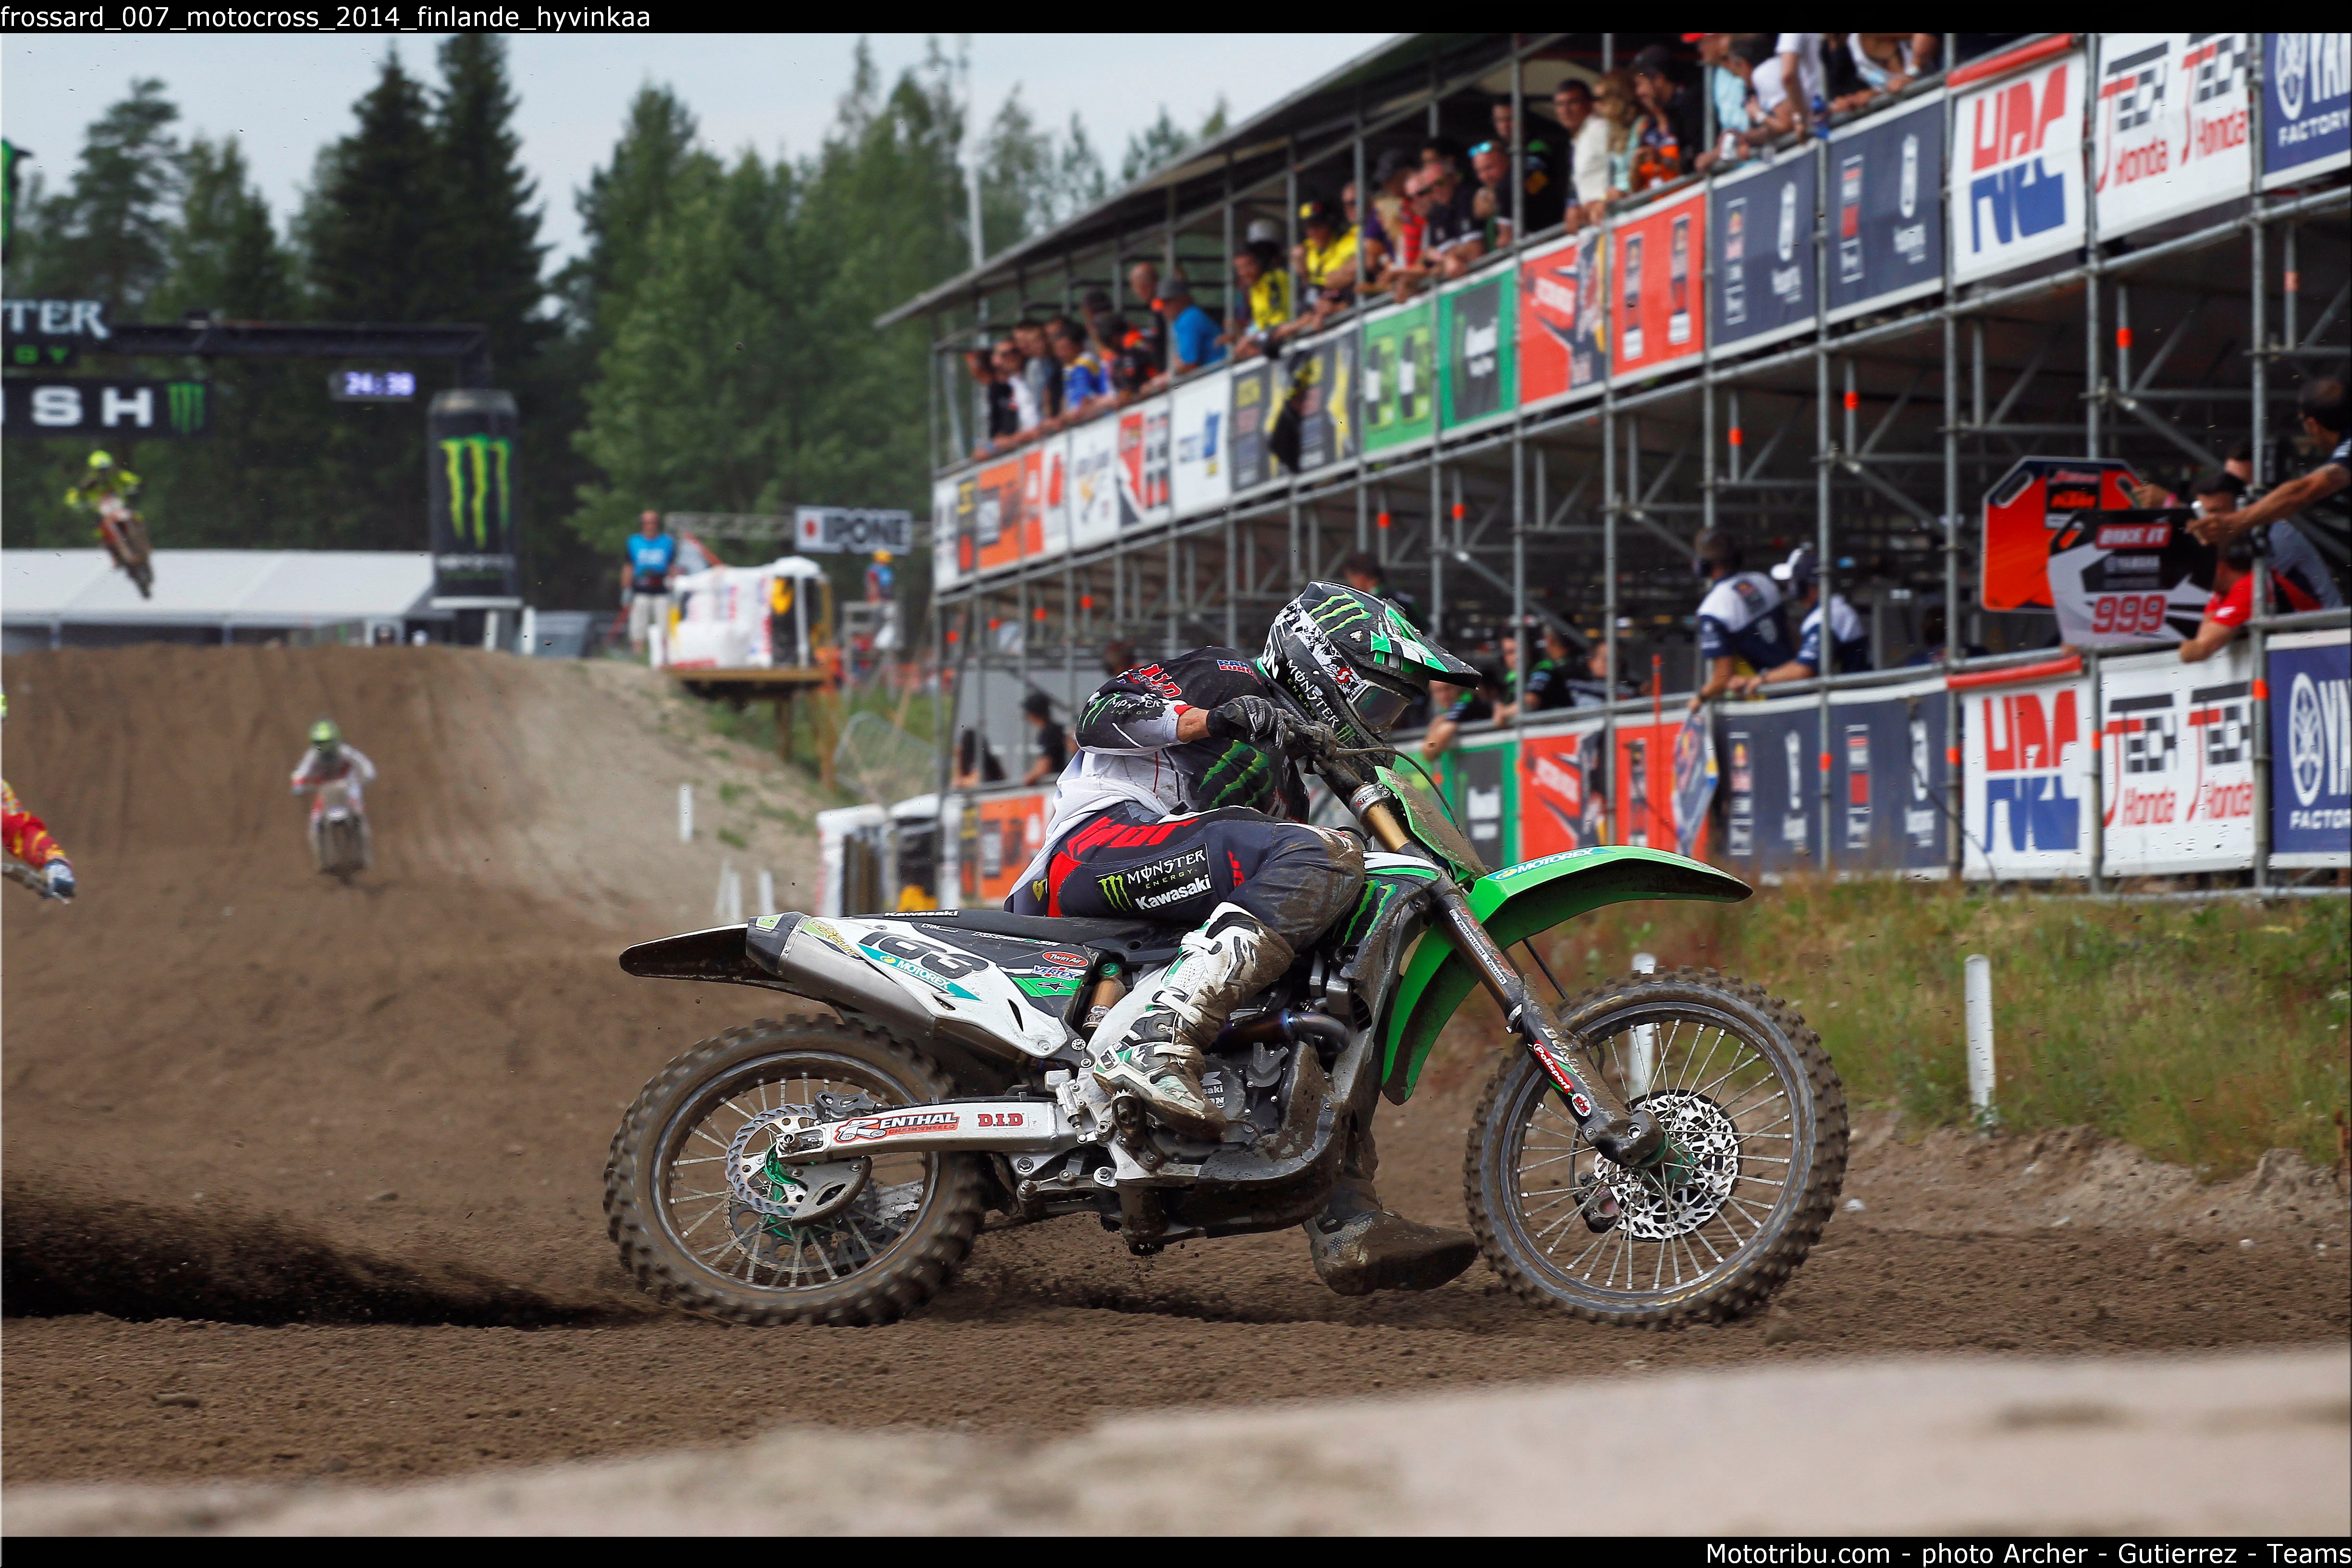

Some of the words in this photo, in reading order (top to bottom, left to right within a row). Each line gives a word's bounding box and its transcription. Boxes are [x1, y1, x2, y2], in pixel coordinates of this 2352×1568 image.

[2114, 136, 2168, 186] Honda
[1, 386, 154, 428] SH
[2092, 595, 2167, 633] 999
[1287, 659, 1339, 728] MONSTER
[1287, 678, 1315, 716] ENERG
[2122, 785, 2176, 826] Honda
[2202, 777, 2254, 821] Honda
[1127, 849, 1206, 884] MONSTER
[1146, 869, 1193, 889] ENERGY
[1517, 848, 1595, 873] MOTOREX
[1135, 874, 1212, 911] Kawasaki
[1456, 917, 1486, 956] Technical
[1484, 957, 1506, 983] Touch
[896, 960, 951, 989] MOTOREX
[1035, 966, 1077, 978] VERTEX
[1535, 1045, 1571, 1090] Polisport
[837, 1113, 957, 1141] RENTHAL
[978, 1113, 1023, 1127] D.I.D
